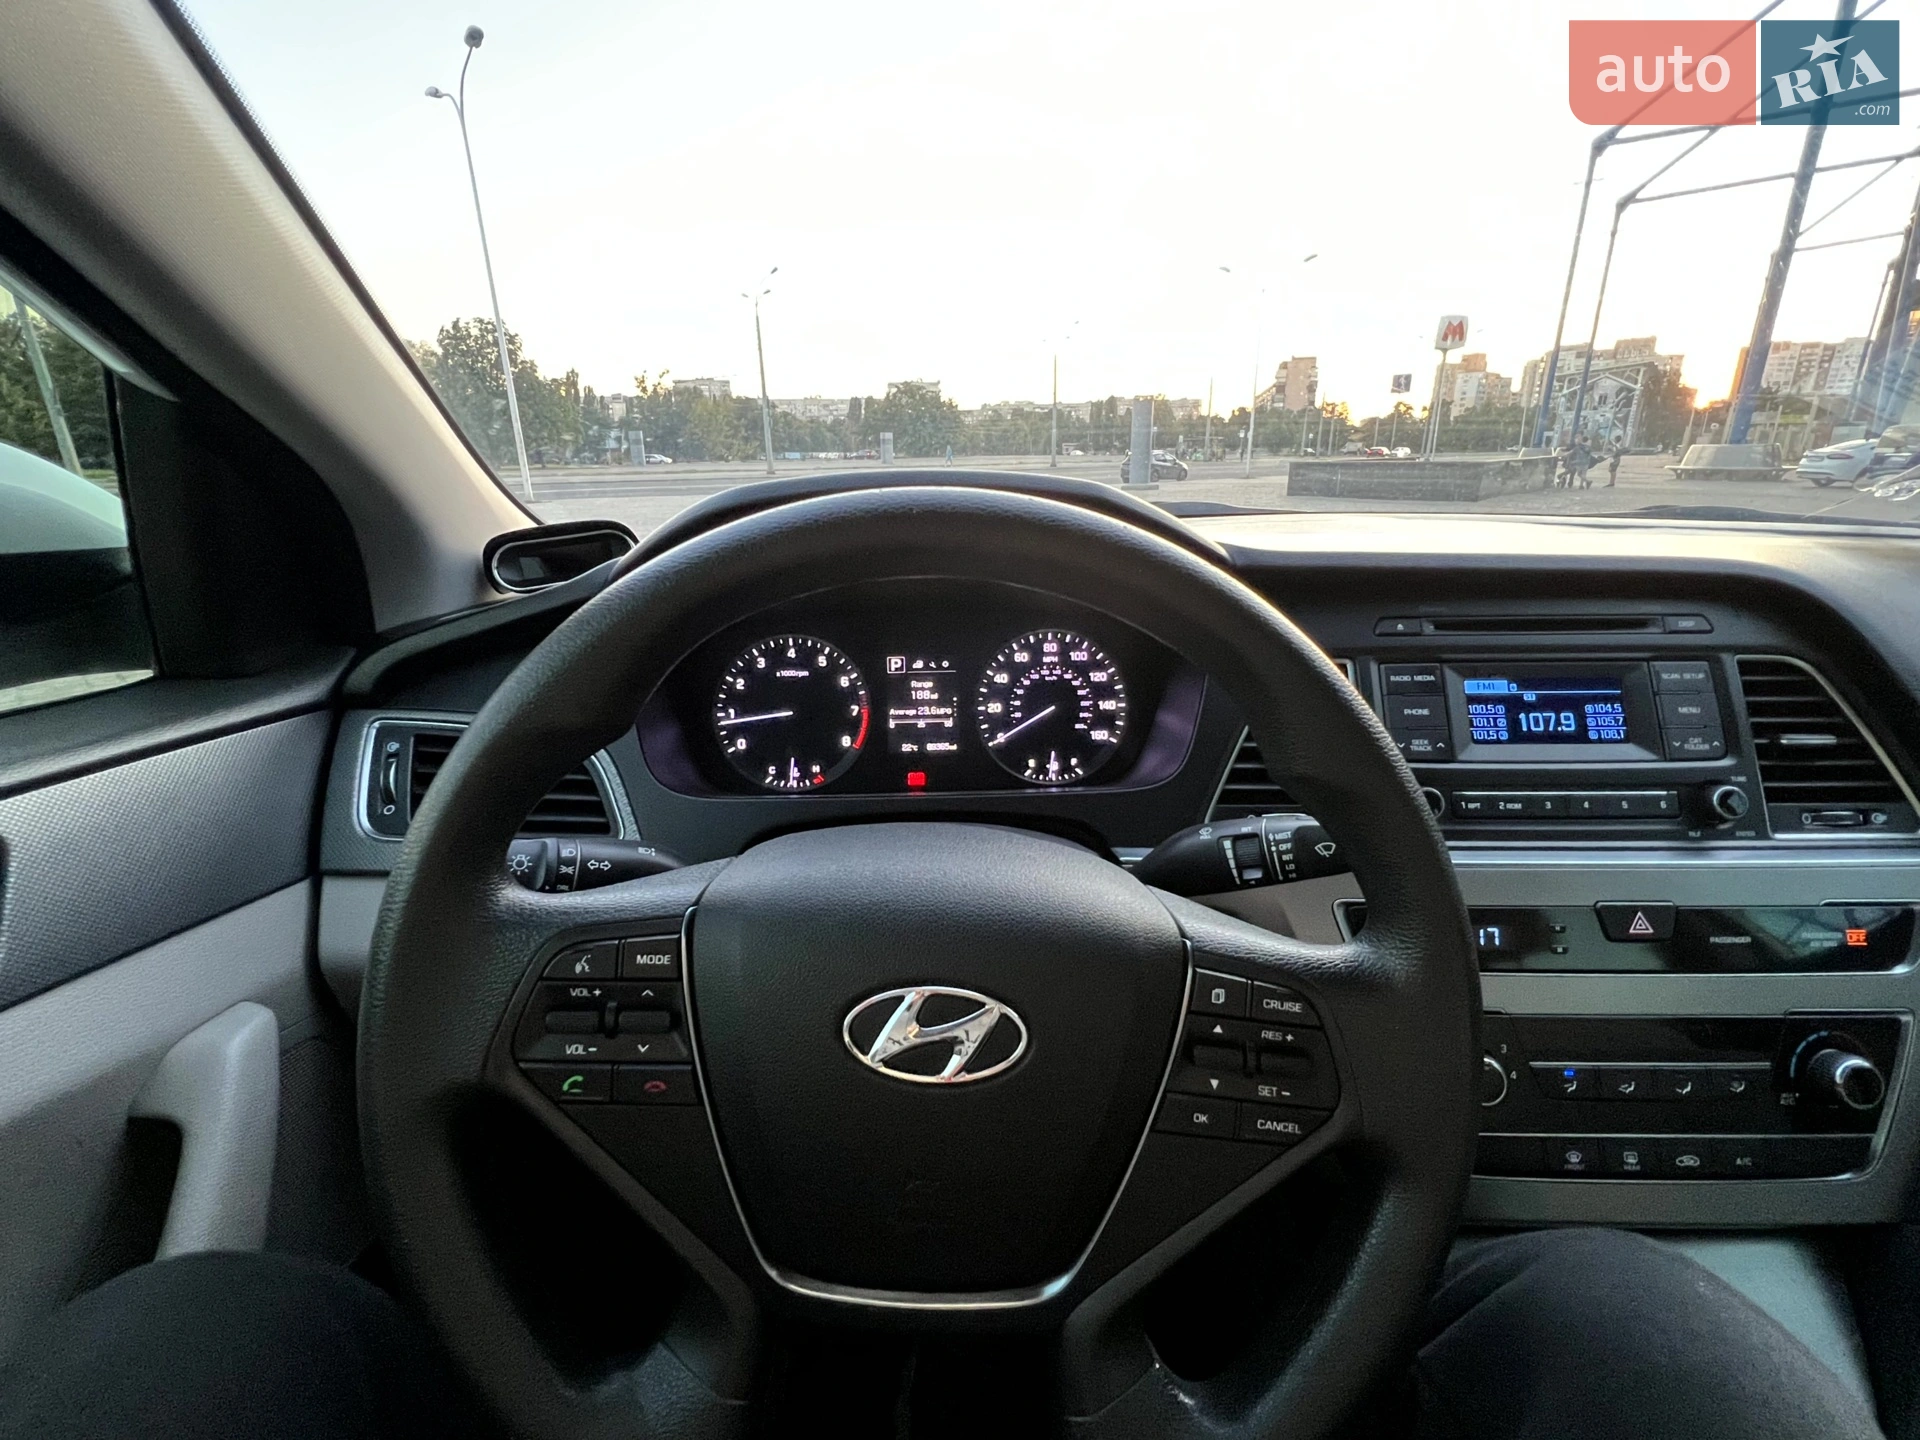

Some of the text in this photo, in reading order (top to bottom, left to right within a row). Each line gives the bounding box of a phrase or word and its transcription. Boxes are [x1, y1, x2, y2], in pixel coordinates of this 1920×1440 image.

[1043, 642, 1057, 652] 80
[787, 648, 796, 658] 4
[1014, 652, 1028, 662] 60
[1069, 651, 1088, 661] 100
[756, 657, 766, 669] 3
[818, 656, 827, 667] 5
[890, 658, 902, 672] P
[840, 676, 849, 687] 6
[994, 673, 1008, 683] 40
[1089, 672, 1107, 682] 120
[1390, 674, 1412, 682] RADIO
[735, 678, 745, 690] 2
[911, 680, 933, 689] Range
[1476, 682, 1495, 691] FM1
[987, 703, 1001, 713] 20
[1098, 700, 1116, 710] 140
[1468, 704, 1495, 714] 100.5
[1594, 703, 1622, 713] 104.5
[1678, 706, 1701, 714] MENU
[728, 709, 735, 719] 1
[850, 705, 860, 717] 7
[889, 708, 917, 716] Average
[1472, 717, 1494, 727] 101.1
[1519, 713, 1576, 732] 107.9
[1595, 716, 1623, 726] 105.7
[1090, 730, 1108, 740] 160
[1472, 730, 1497, 740] 101.5
[736, 738, 746, 750] 0
[842, 735, 851, 747] 8
[768, 765, 776, 775] C
[812, 765, 820, 773] H
[1499, 801, 1505, 810] 2
[1545, 801, 1551, 809] 3
[1583, 801, 1589, 809] 4
[1621, 801, 1628, 809] 5
[1660, 800, 1667, 809] 6
[1274, 831, 1292, 840] MIST
[1278, 843, 1292, 851] OFF
[1282, 853, 1293, 861] INT
[1846, 933, 1866, 942] OFF
[636, 954, 671, 965] MODE
[1263, 998, 1303, 1013] CRUISE
[1500, 1044, 1507, 1054] 3
[1510, 1071, 1517, 1080] 4
[1193, 1112, 1209, 1125] OK
[1257, 1119, 1302, 1135] CANCEL
[1735, 1157, 1752, 1166] A/C
